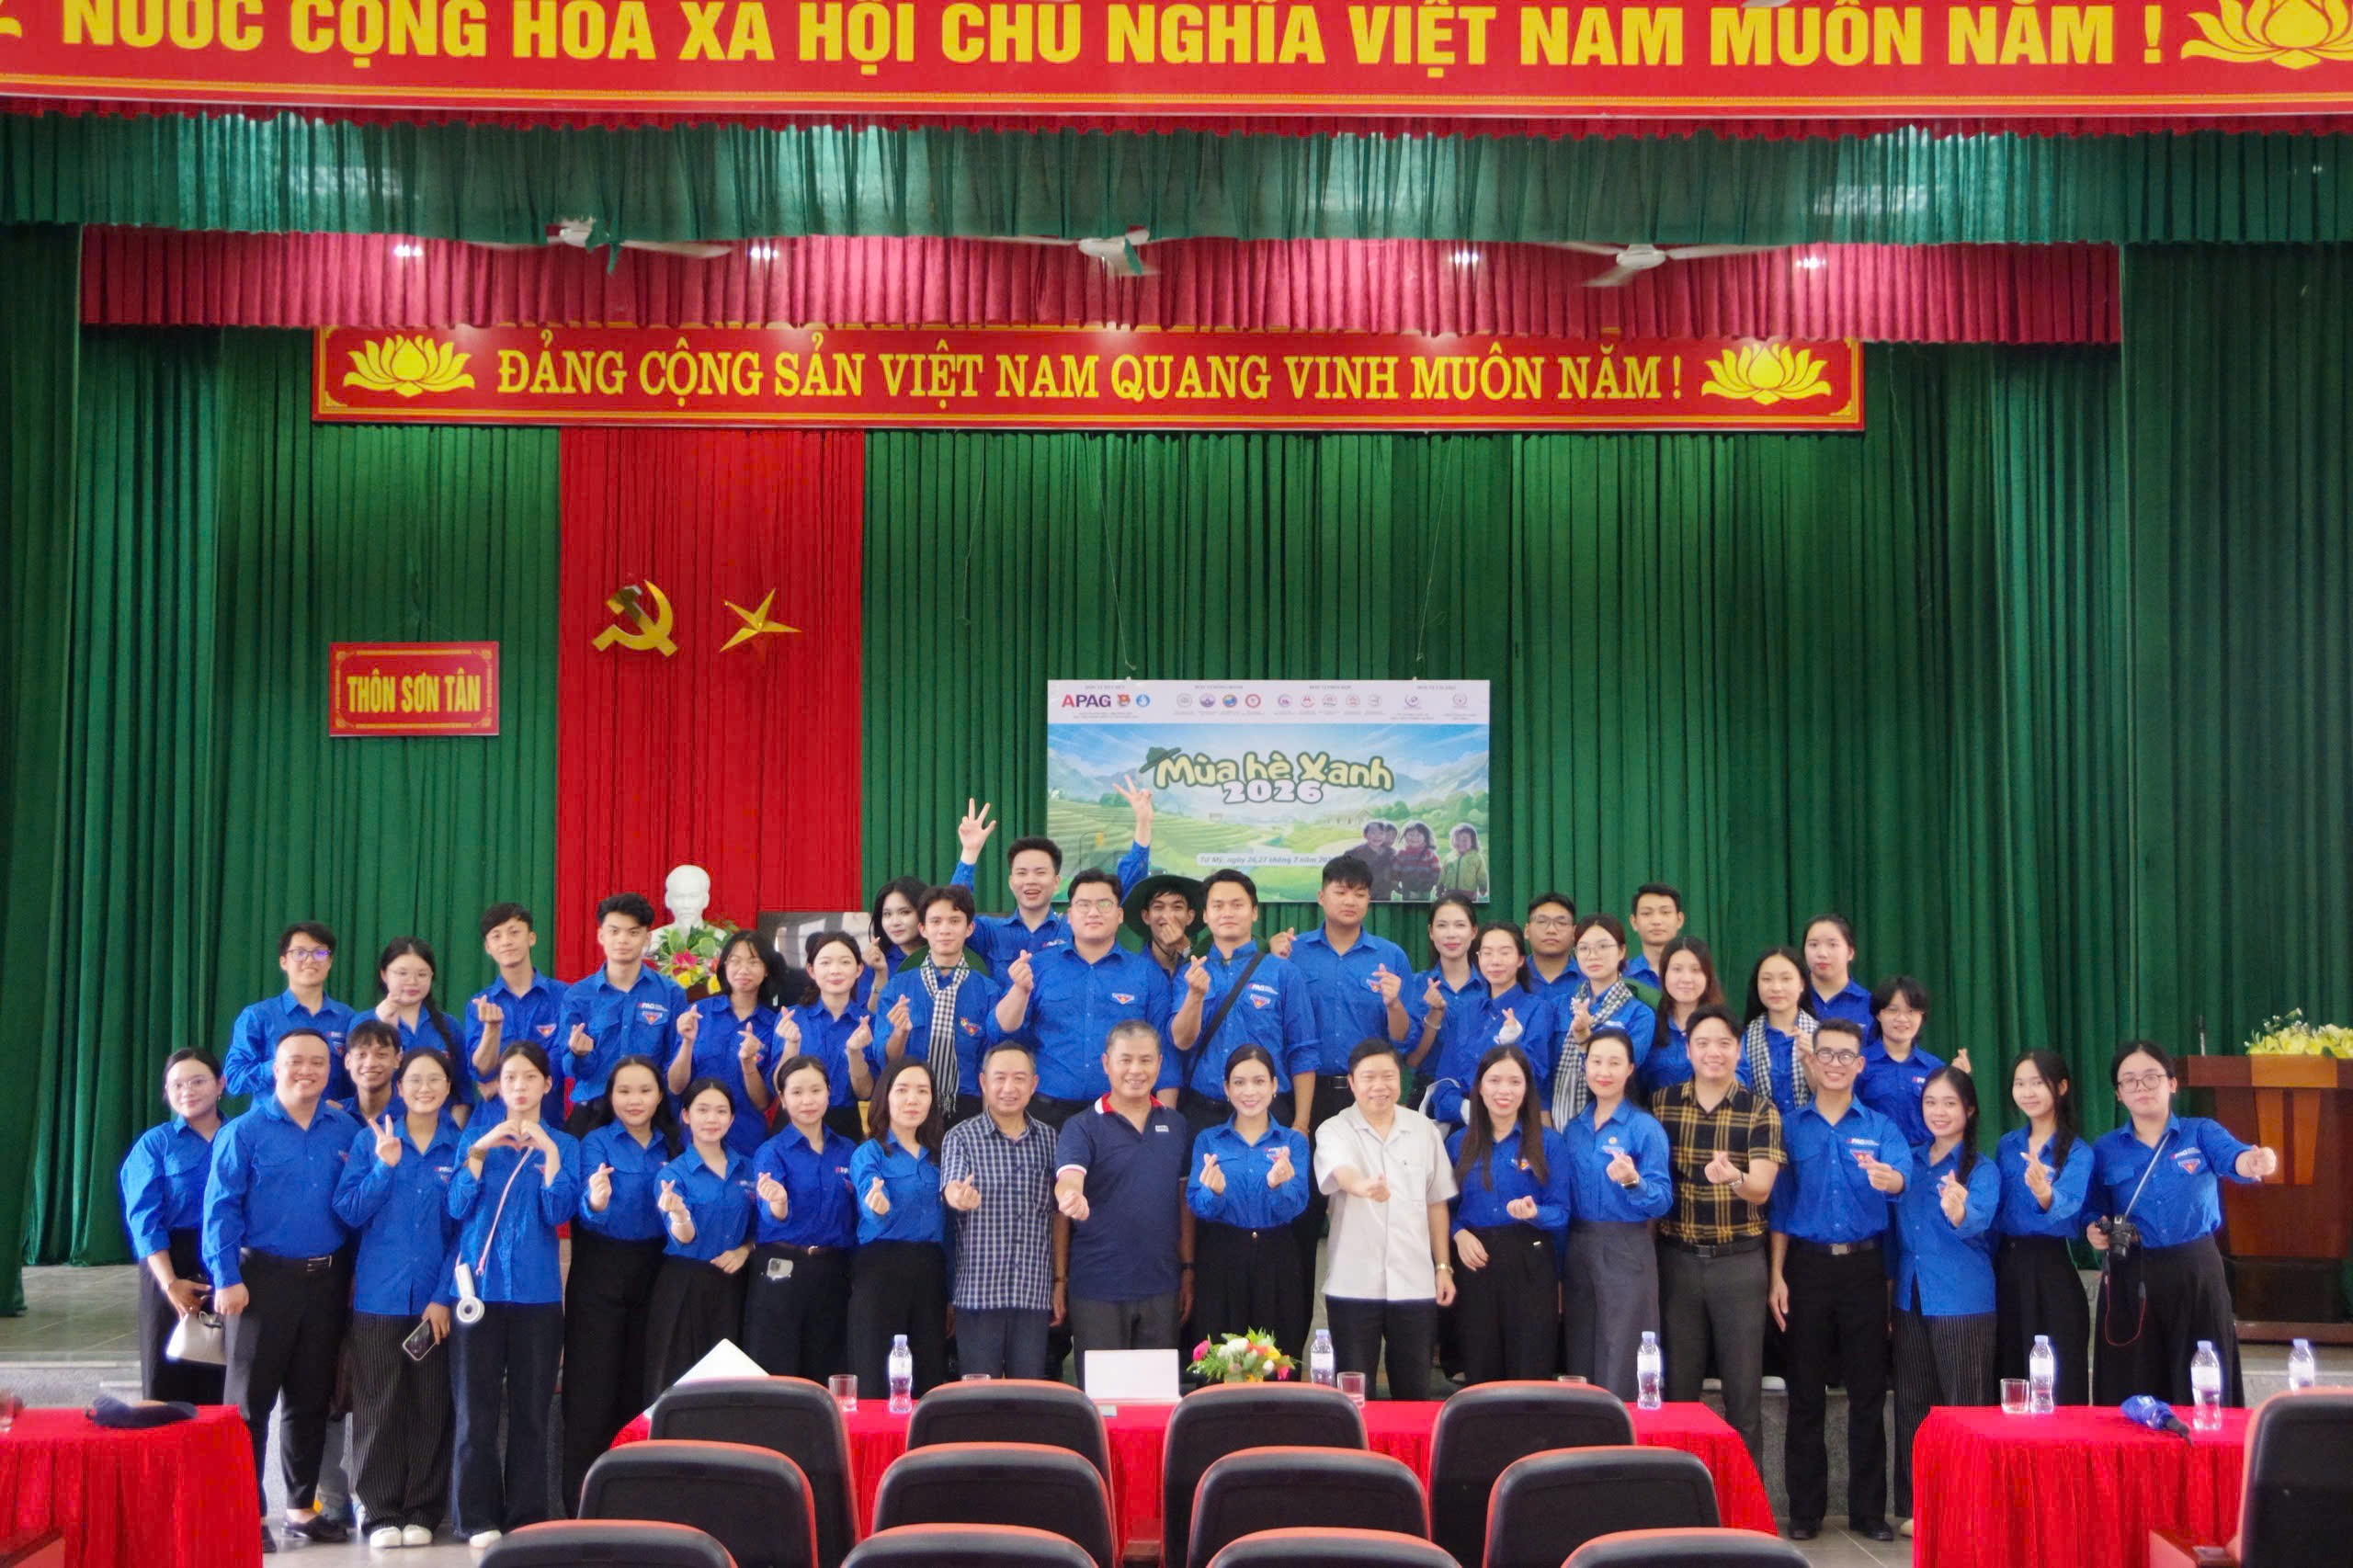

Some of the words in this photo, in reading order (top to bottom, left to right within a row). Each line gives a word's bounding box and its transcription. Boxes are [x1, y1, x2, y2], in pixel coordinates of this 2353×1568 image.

[1348, 0, 1497, 78] VIỆT
[1520, 6, 1684, 65] NAM
[1711, 0, 1923, 66] MUÔN
[2143, 5, 2162, 63] !
[497, 329, 627, 395] ĐẢNG
[639, 336, 764, 407] CỘNG
[775, 332, 866, 397] SẢN
[879, 338, 983, 409] VIỆT
[995, 354, 1099, 398] NAM
[1111, 354, 1272, 403] QUANG
[1284, 356, 1399, 400] VINH
[1410, 341, 1545, 401] MUÔN
[1557, 344, 1662, 400] NĂM
[1673, 355, 1682, 400] !
[347, 667, 396, 713] THÔN
[401, 672, 440, 713] SƠN
[444, 666, 481, 712] TÂN
[1062, 694, 1111, 708] APAG
[1154, 751, 1239, 789] Mùa
[1244, 750, 1293, 781] hè
[1297, 752, 1394, 791] Xanh
[1223, 778, 1324, 804] 2026
